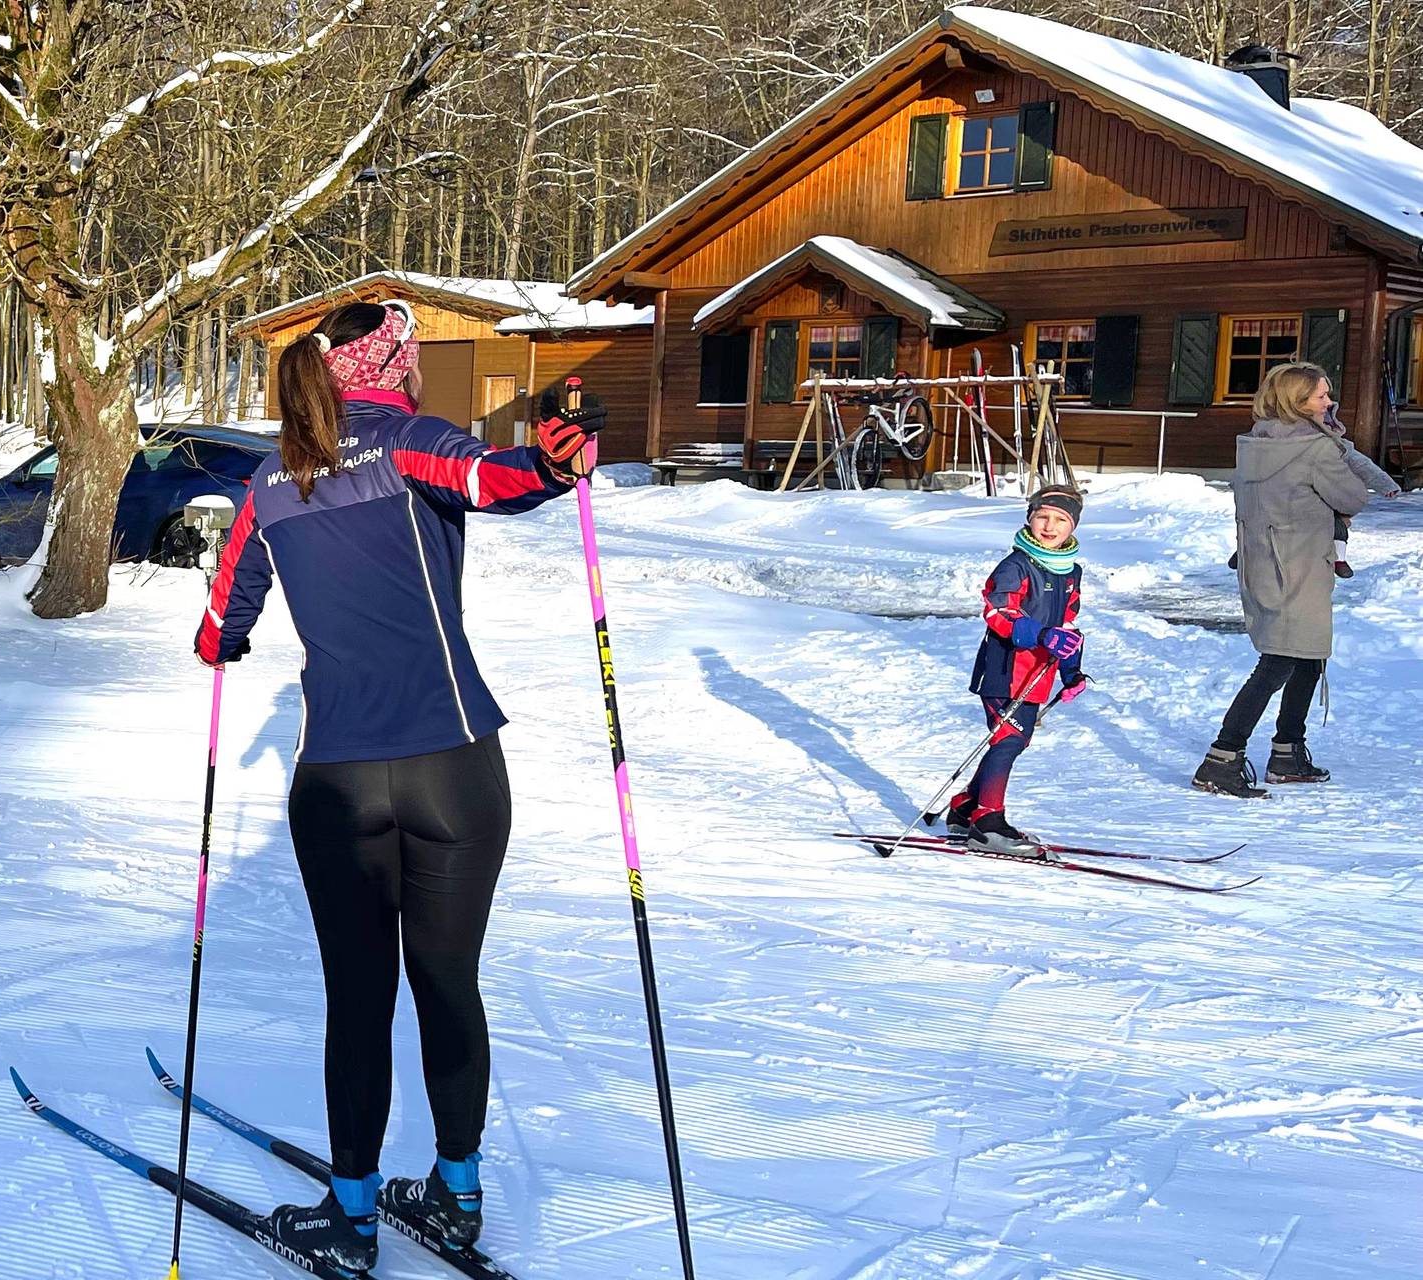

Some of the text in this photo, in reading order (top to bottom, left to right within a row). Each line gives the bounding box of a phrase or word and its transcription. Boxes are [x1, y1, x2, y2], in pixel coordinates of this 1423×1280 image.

[1008, 217, 1231, 243] Skihütte Pastorenwiese
[598, 631, 616, 686] LEKI
